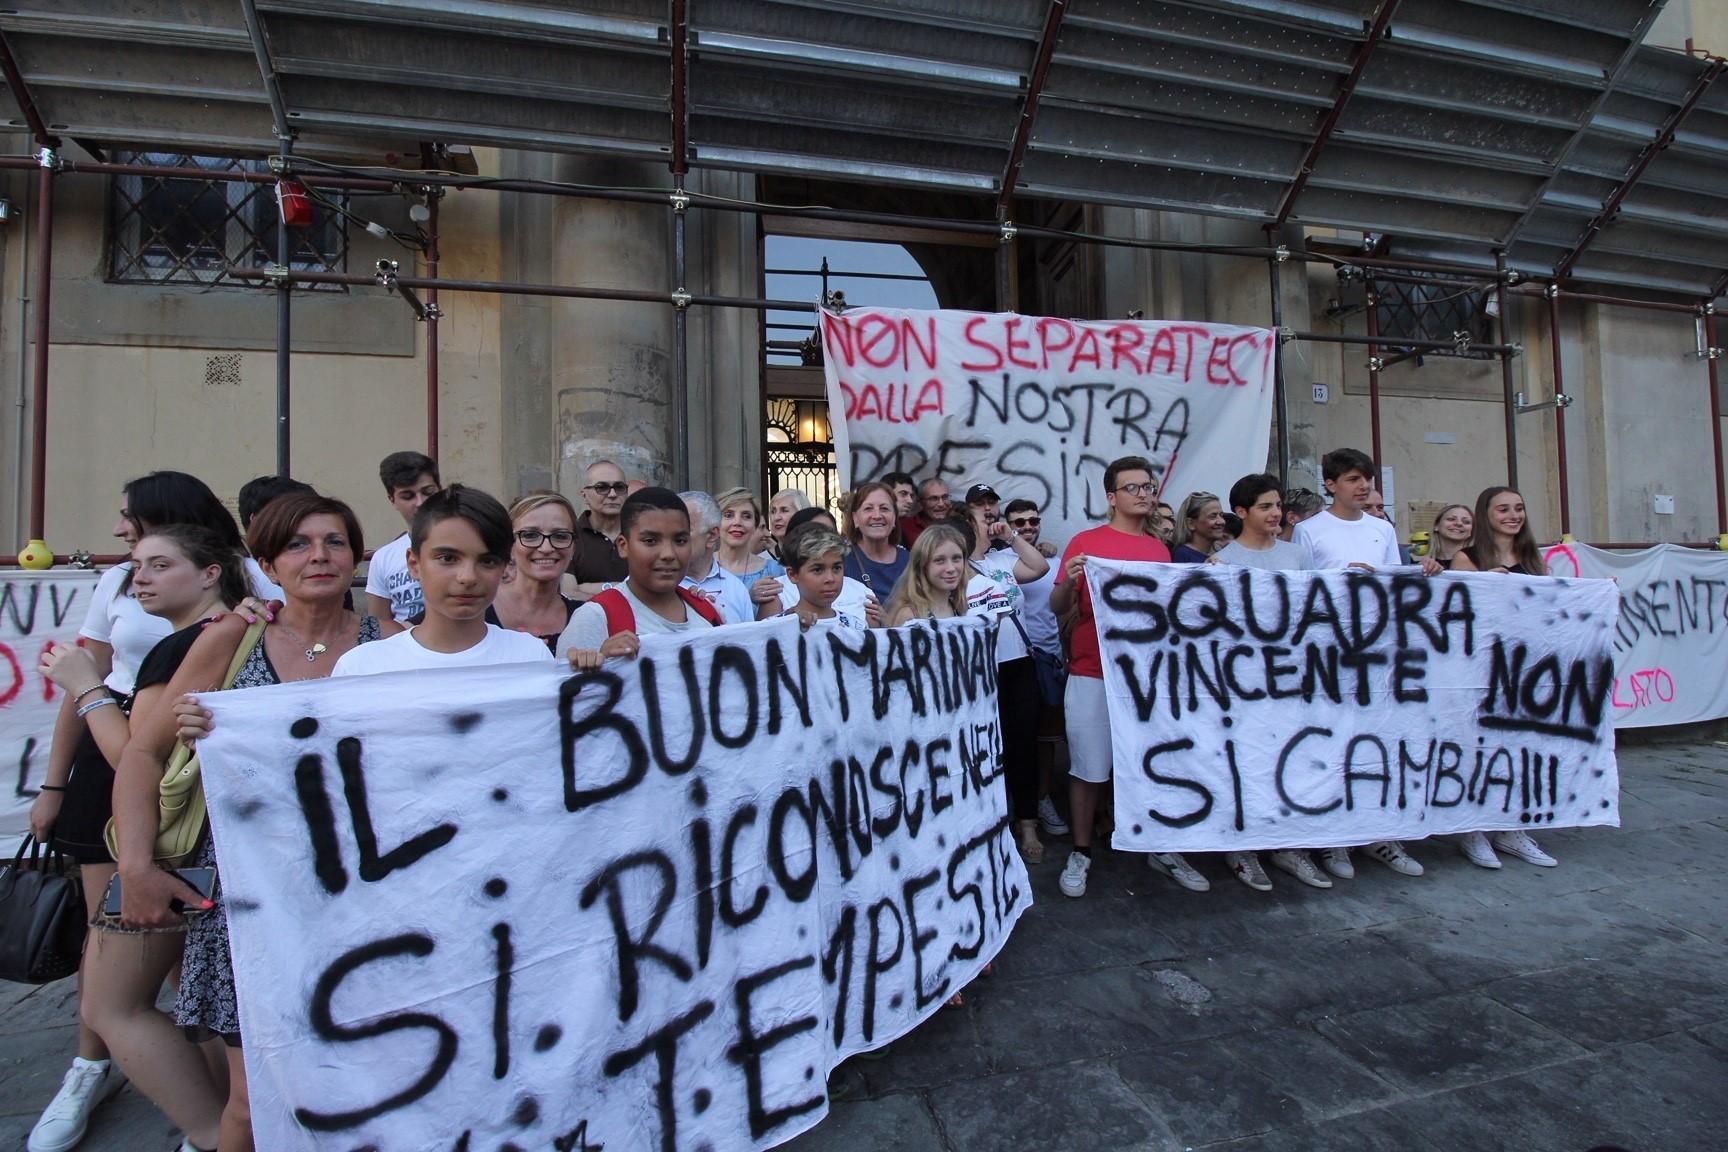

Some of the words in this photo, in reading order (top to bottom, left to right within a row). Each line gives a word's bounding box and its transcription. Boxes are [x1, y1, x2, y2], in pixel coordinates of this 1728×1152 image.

[840, 379, 944, 423] DALLA
[966, 373, 1190, 451] NOSTRA
[1102, 569, 1476, 656] SQUADRA
[558, 635, 812, 812] BUON
[1487, 636, 1614, 727] NON
